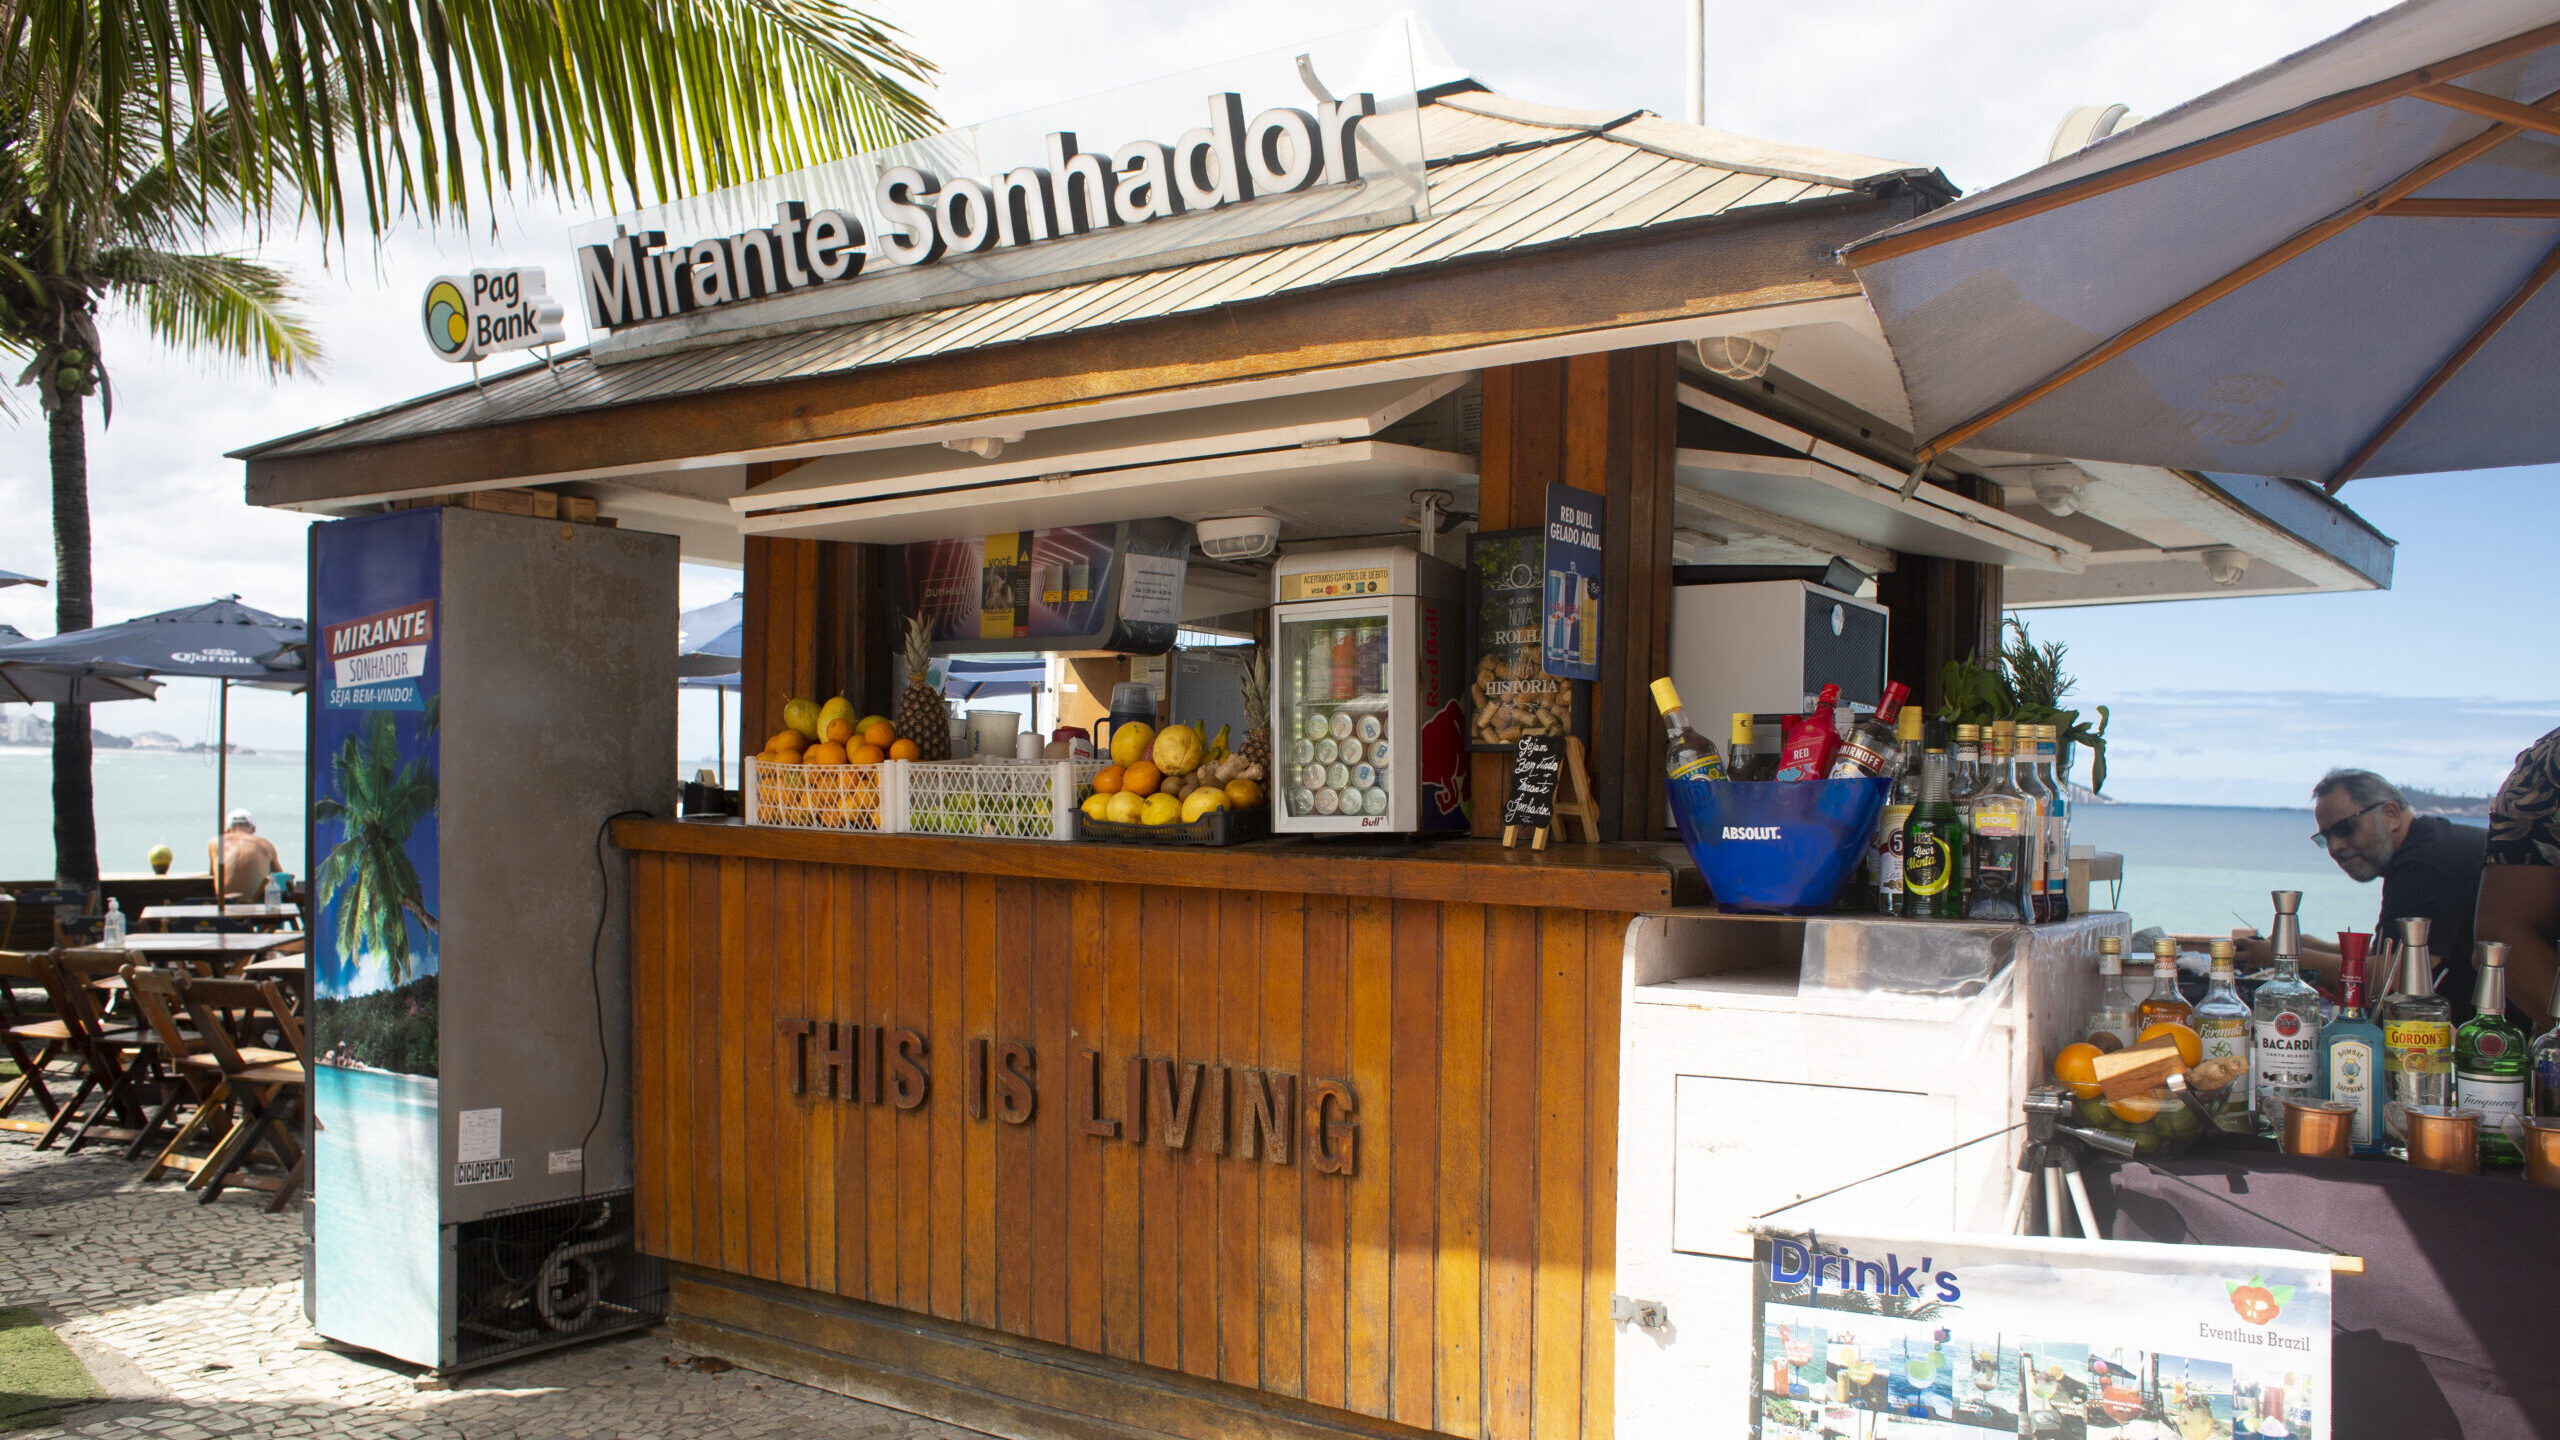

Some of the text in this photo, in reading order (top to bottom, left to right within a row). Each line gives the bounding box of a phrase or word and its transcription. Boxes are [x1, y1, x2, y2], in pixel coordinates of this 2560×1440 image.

[578, 92, 1375, 329] Mirante Sonhador
[473, 272, 520, 308] Pag
[477, 302, 538, 347] Bank
[1560, 505, 1593, 529] RED BULL
[1550, 522, 1602, 551] GELADO AQUI.
[1304, 573, 1334, 584] ACEITAMOS
[1360, 571, 1367, 580] DE
[1509, 607, 1533, 627] NOVA
[333, 609, 427, 655] MIRANTE
[349, 652, 409, 682] SONHADOR
[1426, 608, 1440, 707] Red Bull
[330, 686, 414, 708] SEJA BEM-VINDO!
[1485, 675, 1558, 696] HISTÓRIA
[1793, 748, 1809, 760] RED
[1838, 744, 1880, 769] MIRNOFF
[1907, 856, 1937, 871] Menta
[2200, 1023, 2242, 1039] Fórmula
[2391, 1030, 2442, 1045] GORDON'S
[776, 1017, 1359, 1176] THIS IS LIVING
[458, 1159, 513, 1183] CICLOPENTANO
[1770, 1237, 1962, 1303] Drink's
[2199, 1321, 2311, 1352] Eventhus Brazil
